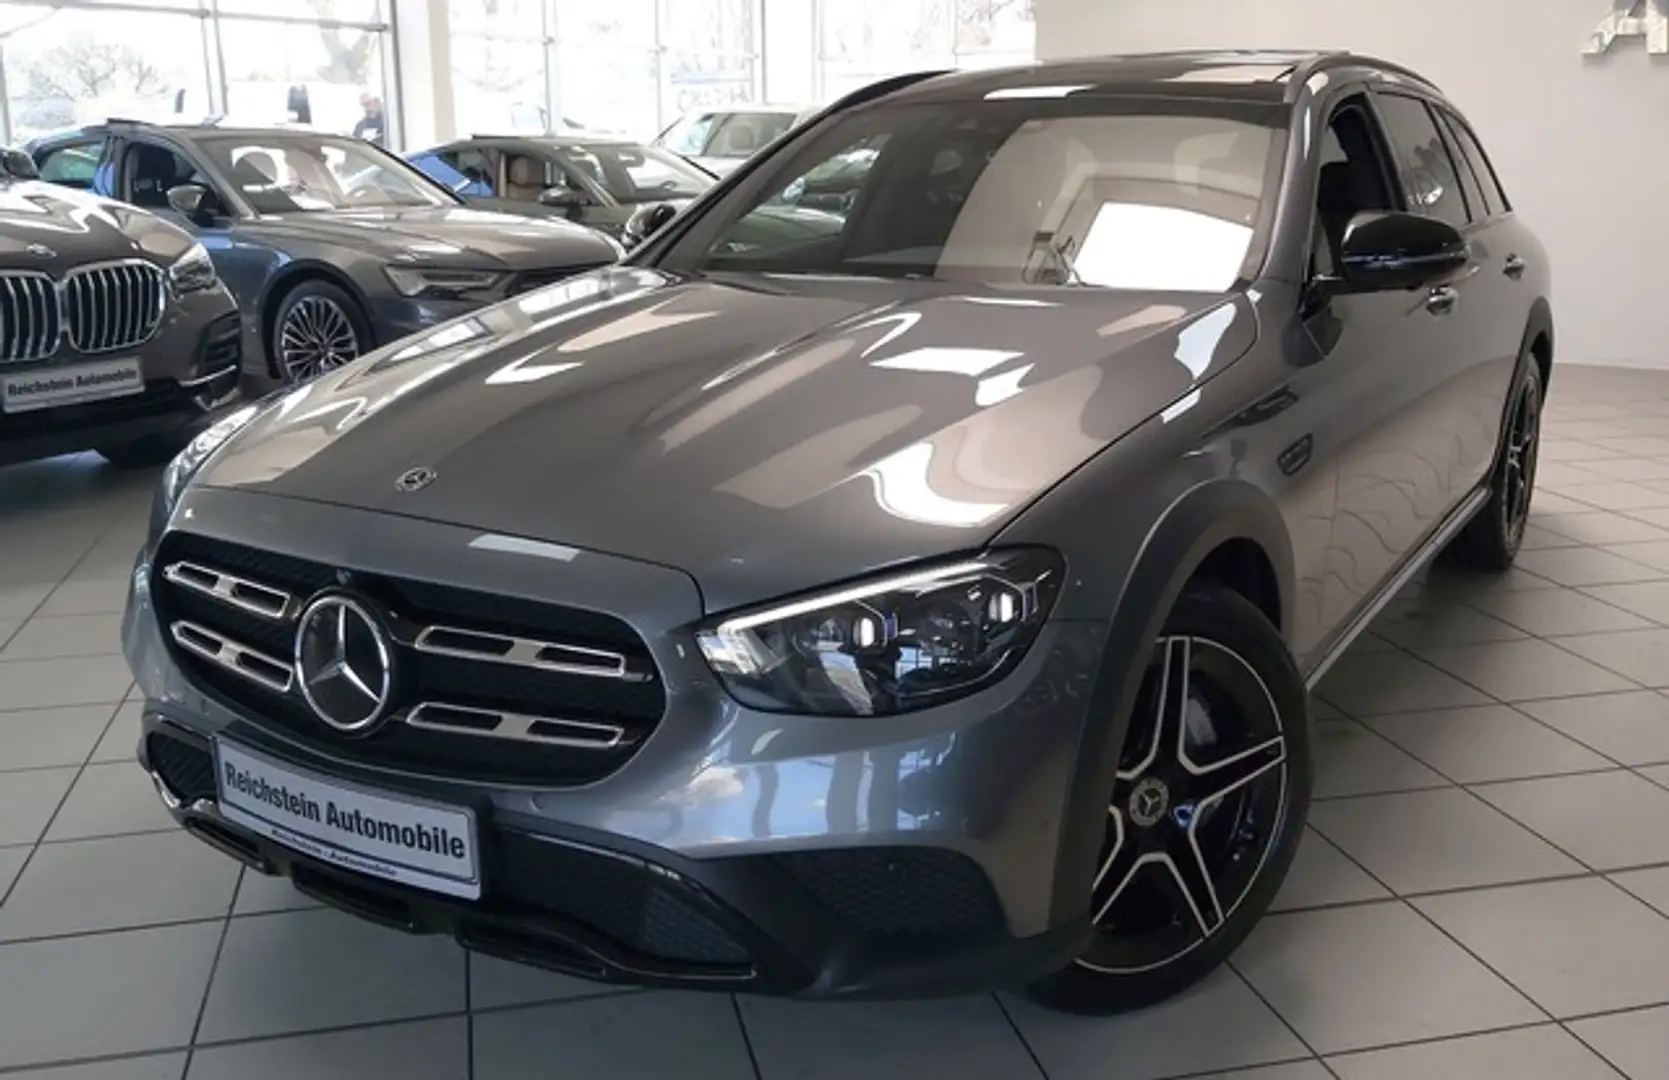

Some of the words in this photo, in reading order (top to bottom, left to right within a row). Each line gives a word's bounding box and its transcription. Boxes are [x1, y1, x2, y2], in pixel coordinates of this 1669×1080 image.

[8, 379, 75, 396] Reichstein
[76, 367, 137, 388] Automobile
[223, 760, 321, 822] Reichstein
[326, 801, 465, 860] Automobile
